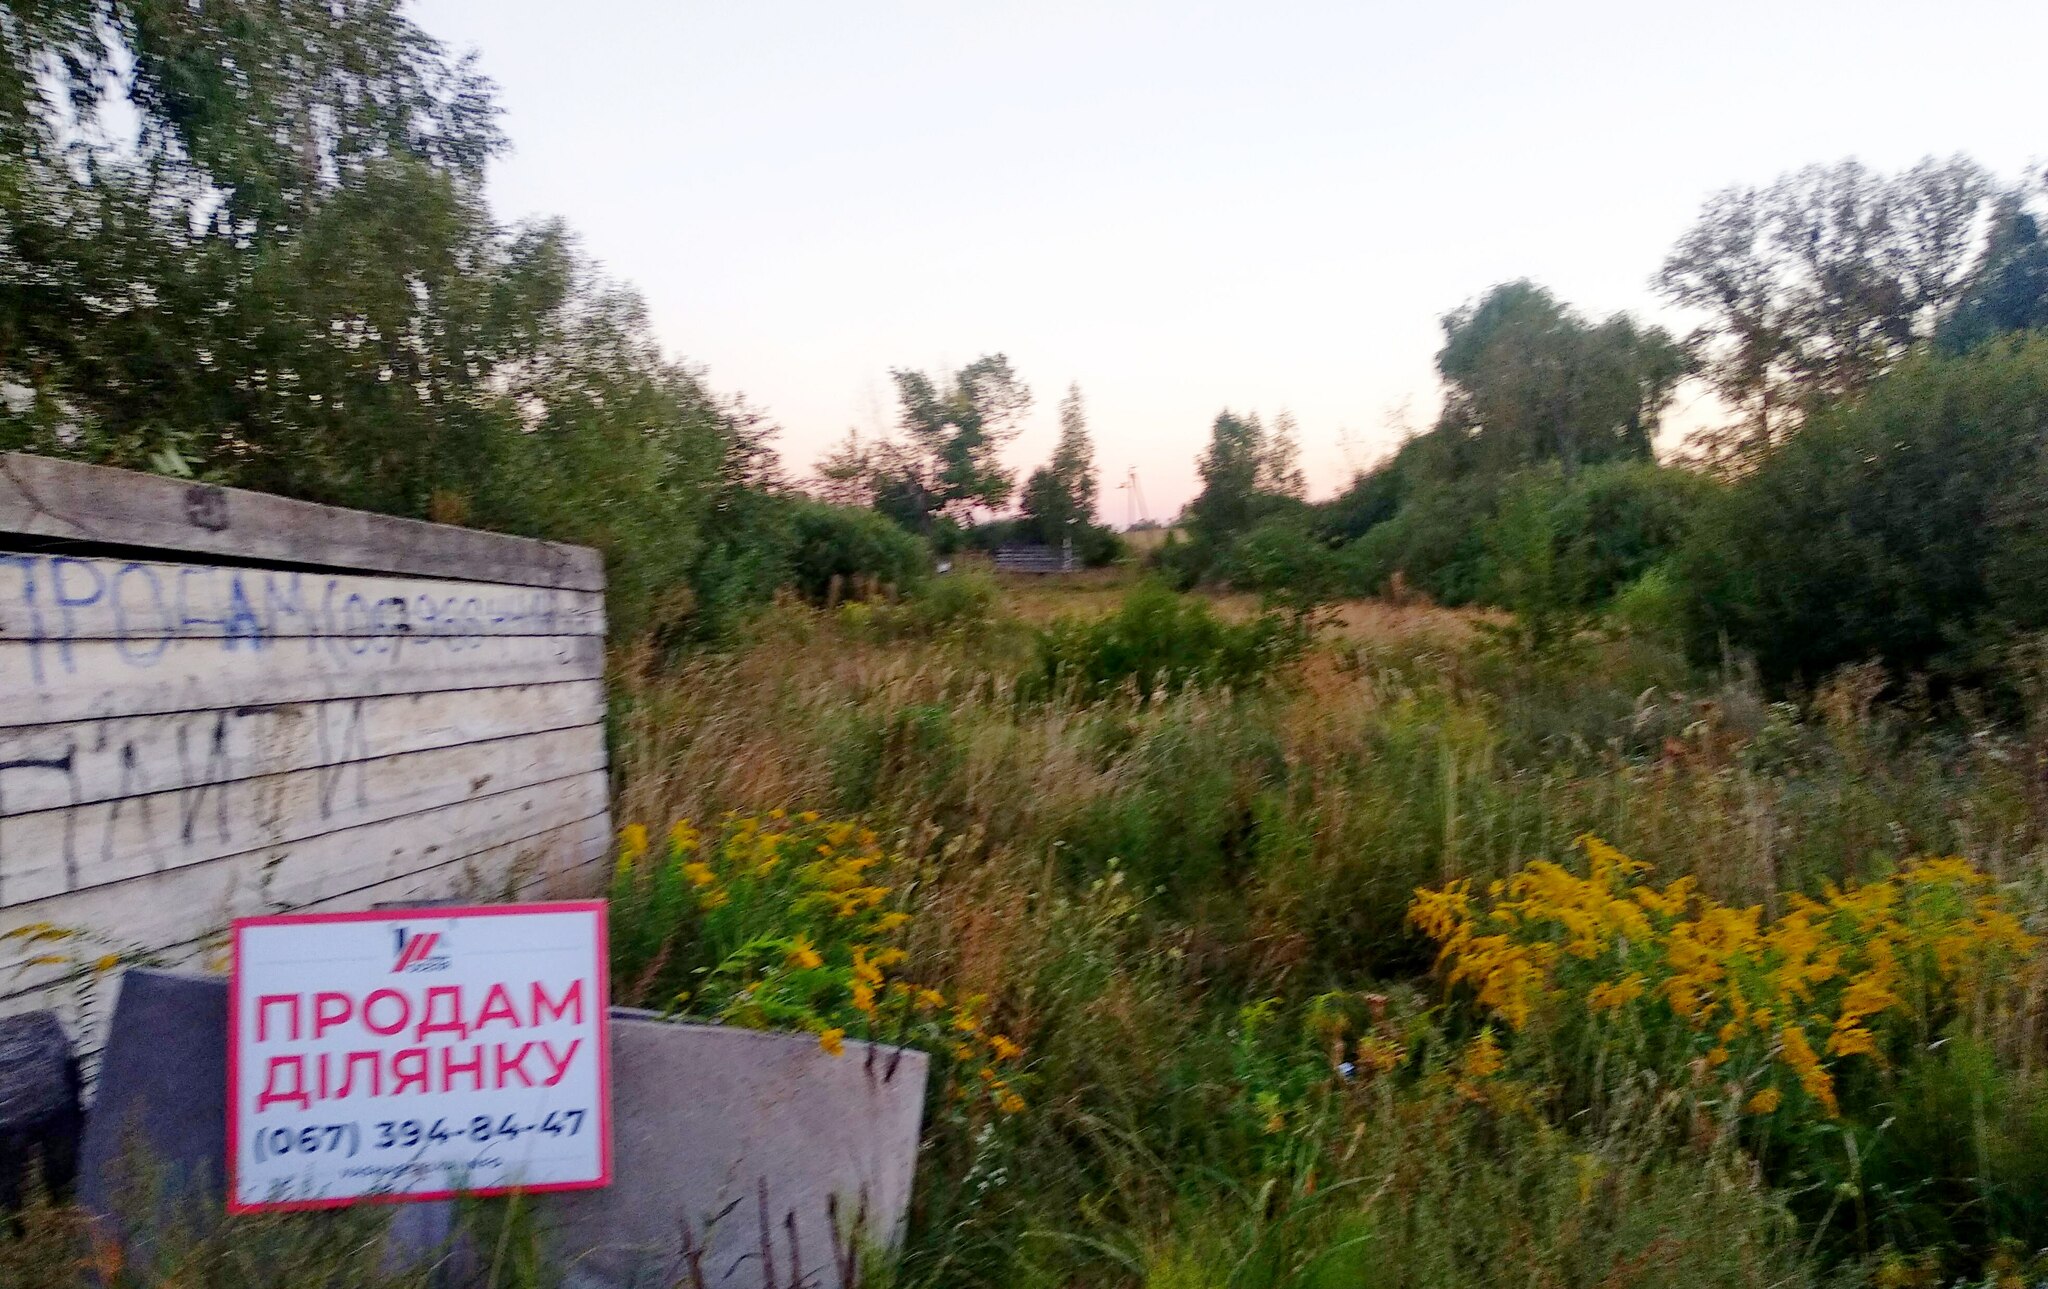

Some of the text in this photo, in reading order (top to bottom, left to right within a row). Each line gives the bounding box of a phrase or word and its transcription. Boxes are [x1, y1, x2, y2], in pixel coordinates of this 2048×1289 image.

[255, 978, 585, 1044] ПРОДАМ
[254, 1037, 585, 1114] ДІЛЯНКУ
[253, 1107, 588, 1164] (067) 394-84-47
